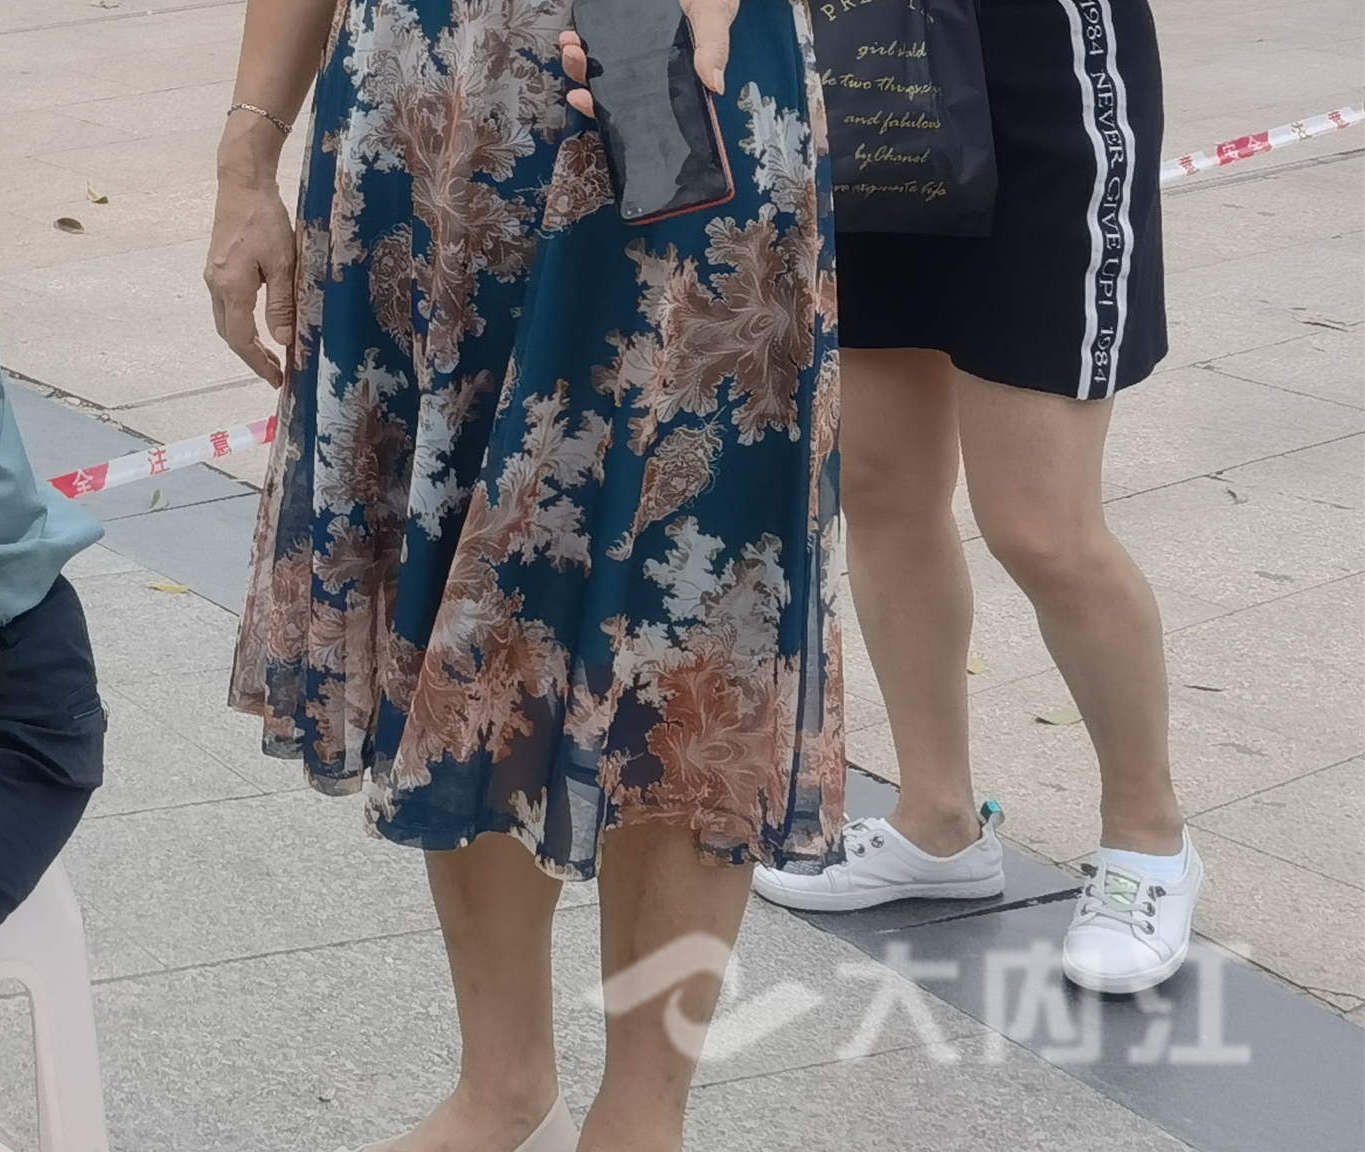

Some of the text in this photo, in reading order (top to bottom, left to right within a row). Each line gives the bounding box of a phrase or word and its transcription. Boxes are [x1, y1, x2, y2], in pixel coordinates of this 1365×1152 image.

[839, 73, 872, 90] two
[843, 110, 883, 125] and
[1090, 68, 1124, 170] NEVER
[1101, 176, 1122, 250] GIVE
[1093, 326, 1115, 384] 1984
